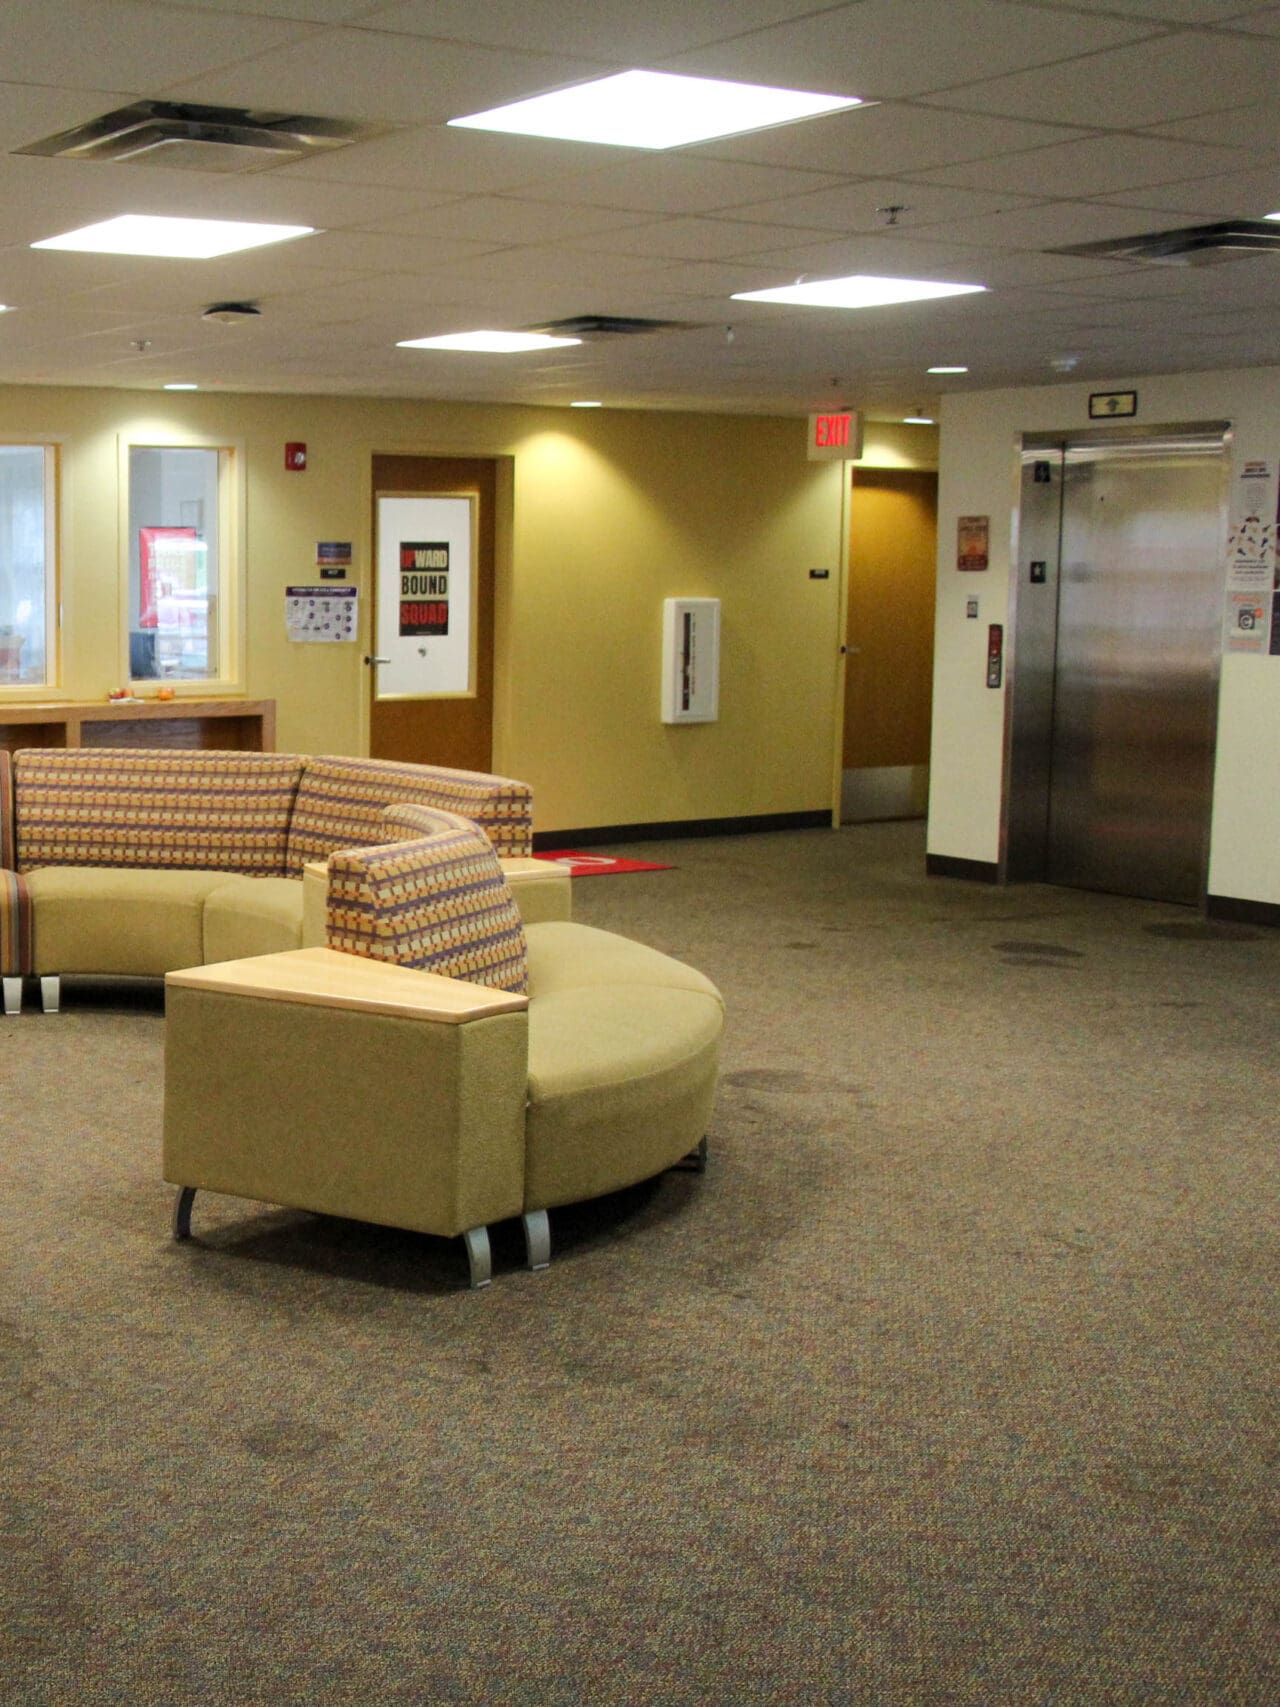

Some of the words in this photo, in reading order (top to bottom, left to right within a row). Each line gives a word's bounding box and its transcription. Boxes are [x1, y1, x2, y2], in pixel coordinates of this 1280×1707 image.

[816, 414, 851, 447] EXIT
[401, 549, 448, 568] UPWARD
[401, 575, 447, 595] BOUND
[401, 603, 447, 625] SQUAD
